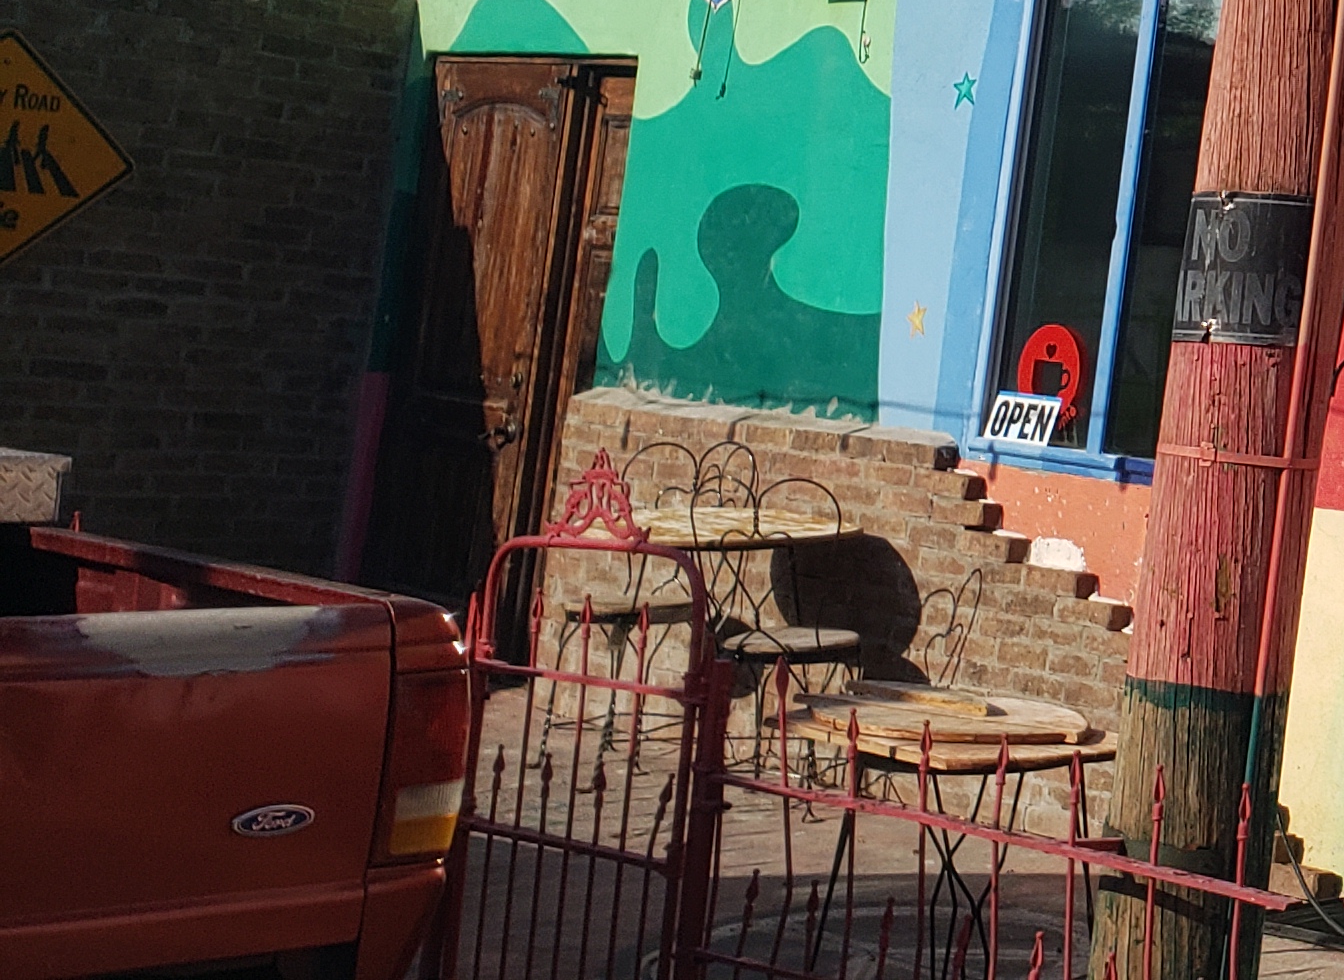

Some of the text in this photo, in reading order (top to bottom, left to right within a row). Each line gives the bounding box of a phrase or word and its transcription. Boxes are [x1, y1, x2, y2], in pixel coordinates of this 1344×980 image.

[1191, 208, 1251, 262] NO
[1176, 270, 1302, 326] RKING
[989, 399, 1056, 443] OPEN
